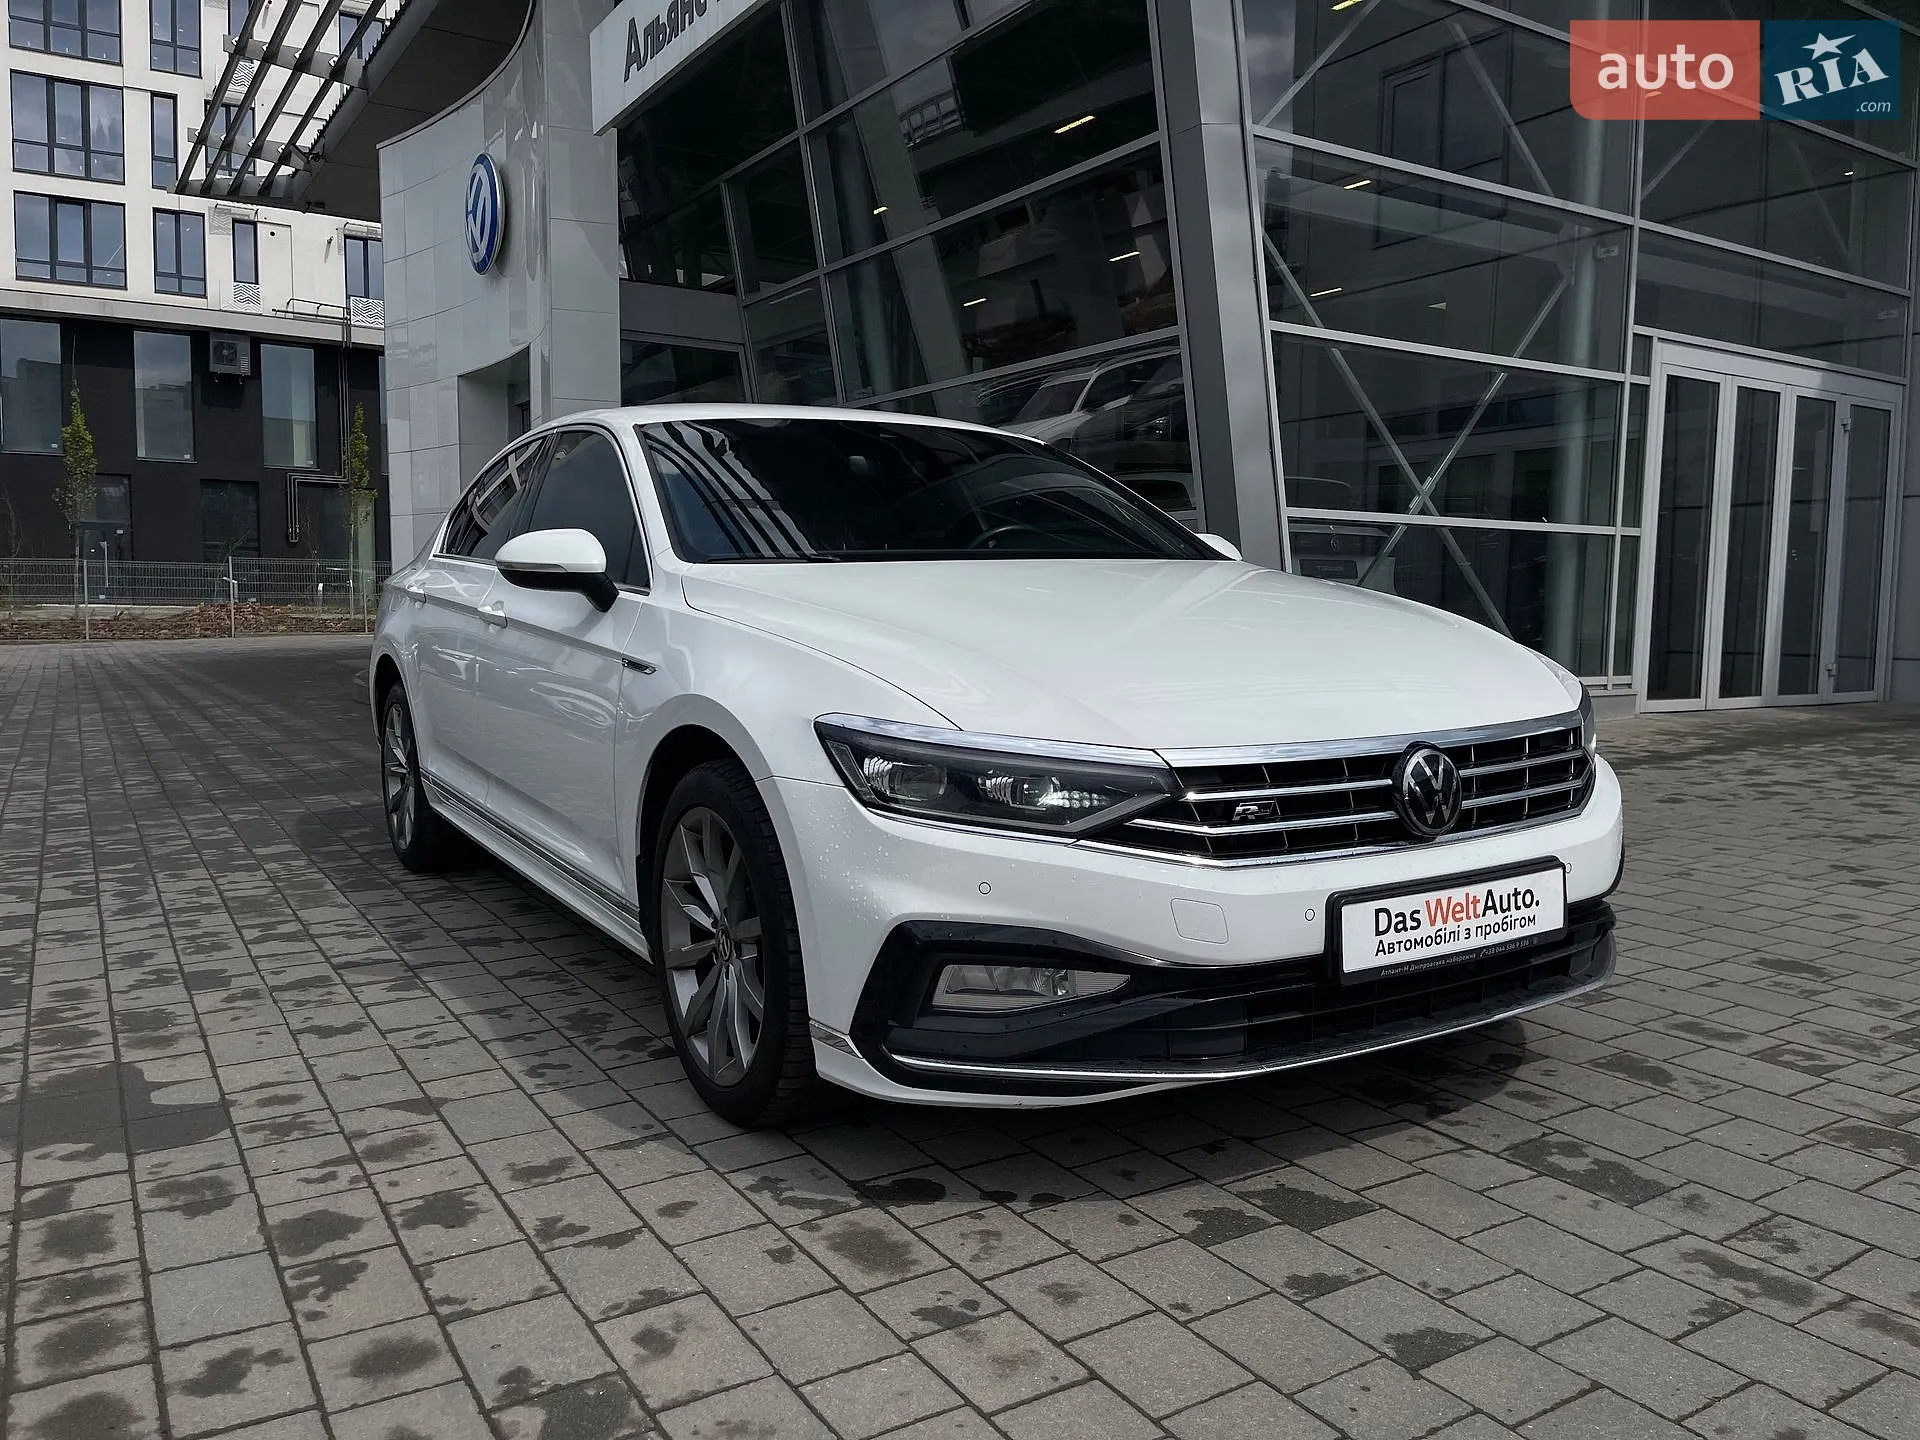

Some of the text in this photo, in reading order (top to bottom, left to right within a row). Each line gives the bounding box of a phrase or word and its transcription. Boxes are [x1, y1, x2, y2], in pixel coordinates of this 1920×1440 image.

[1374, 907, 1422, 937] Das
[1375, 914, 1536, 957] Автомобілі з пробігом
